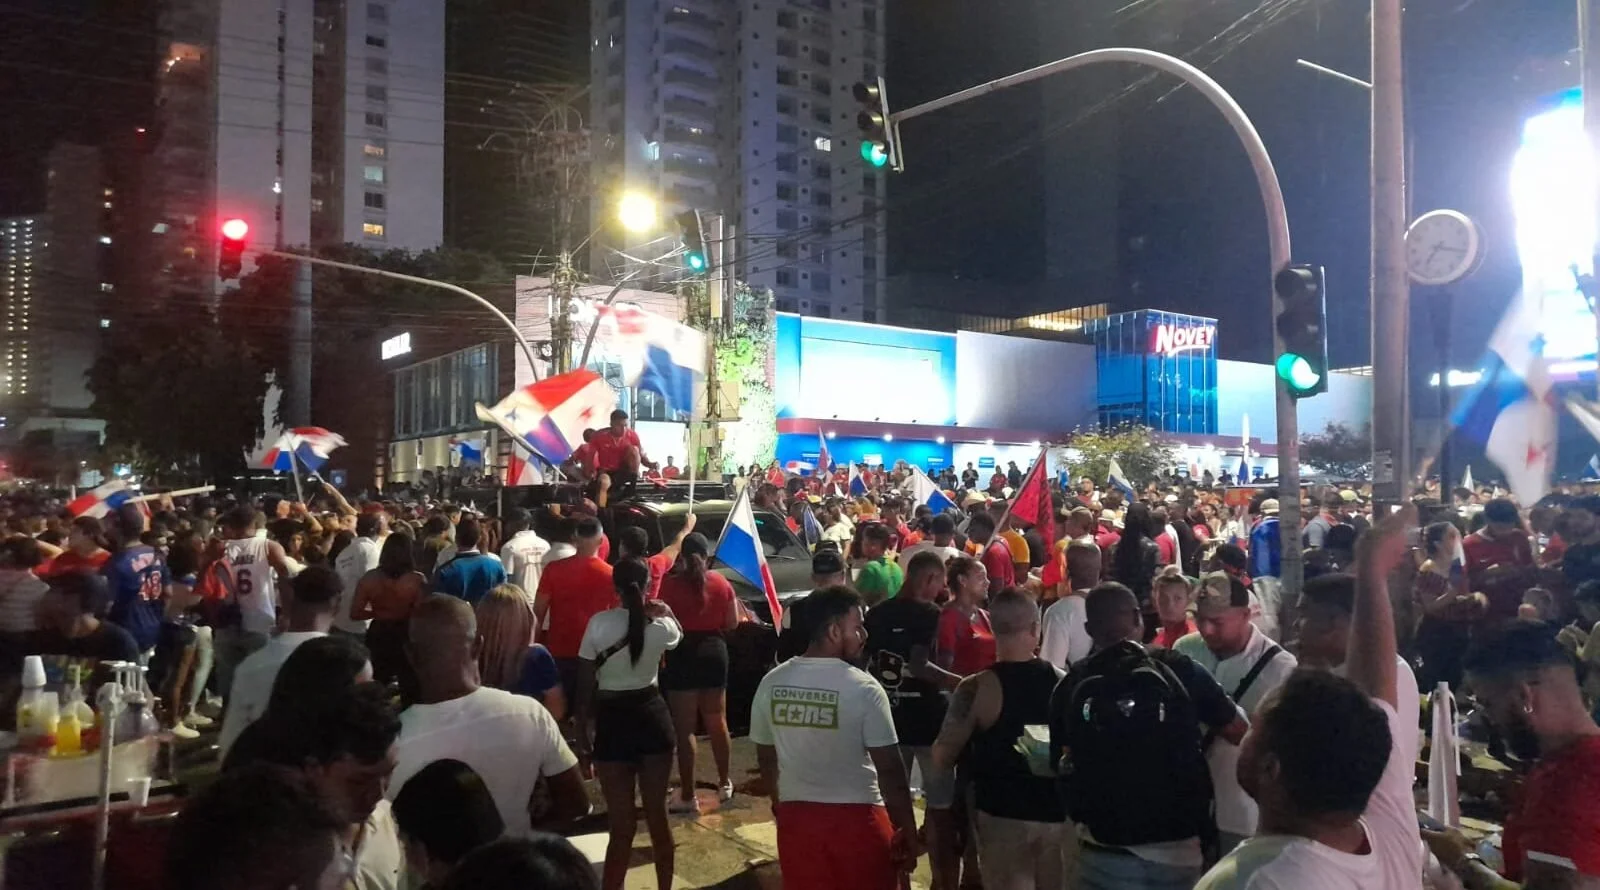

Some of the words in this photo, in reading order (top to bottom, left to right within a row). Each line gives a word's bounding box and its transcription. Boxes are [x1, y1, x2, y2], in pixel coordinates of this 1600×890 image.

[1155, 324, 1216, 354] NOVEY
[236, 568, 253, 595] 6
[774, 688, 835, 703] CONVERSE
